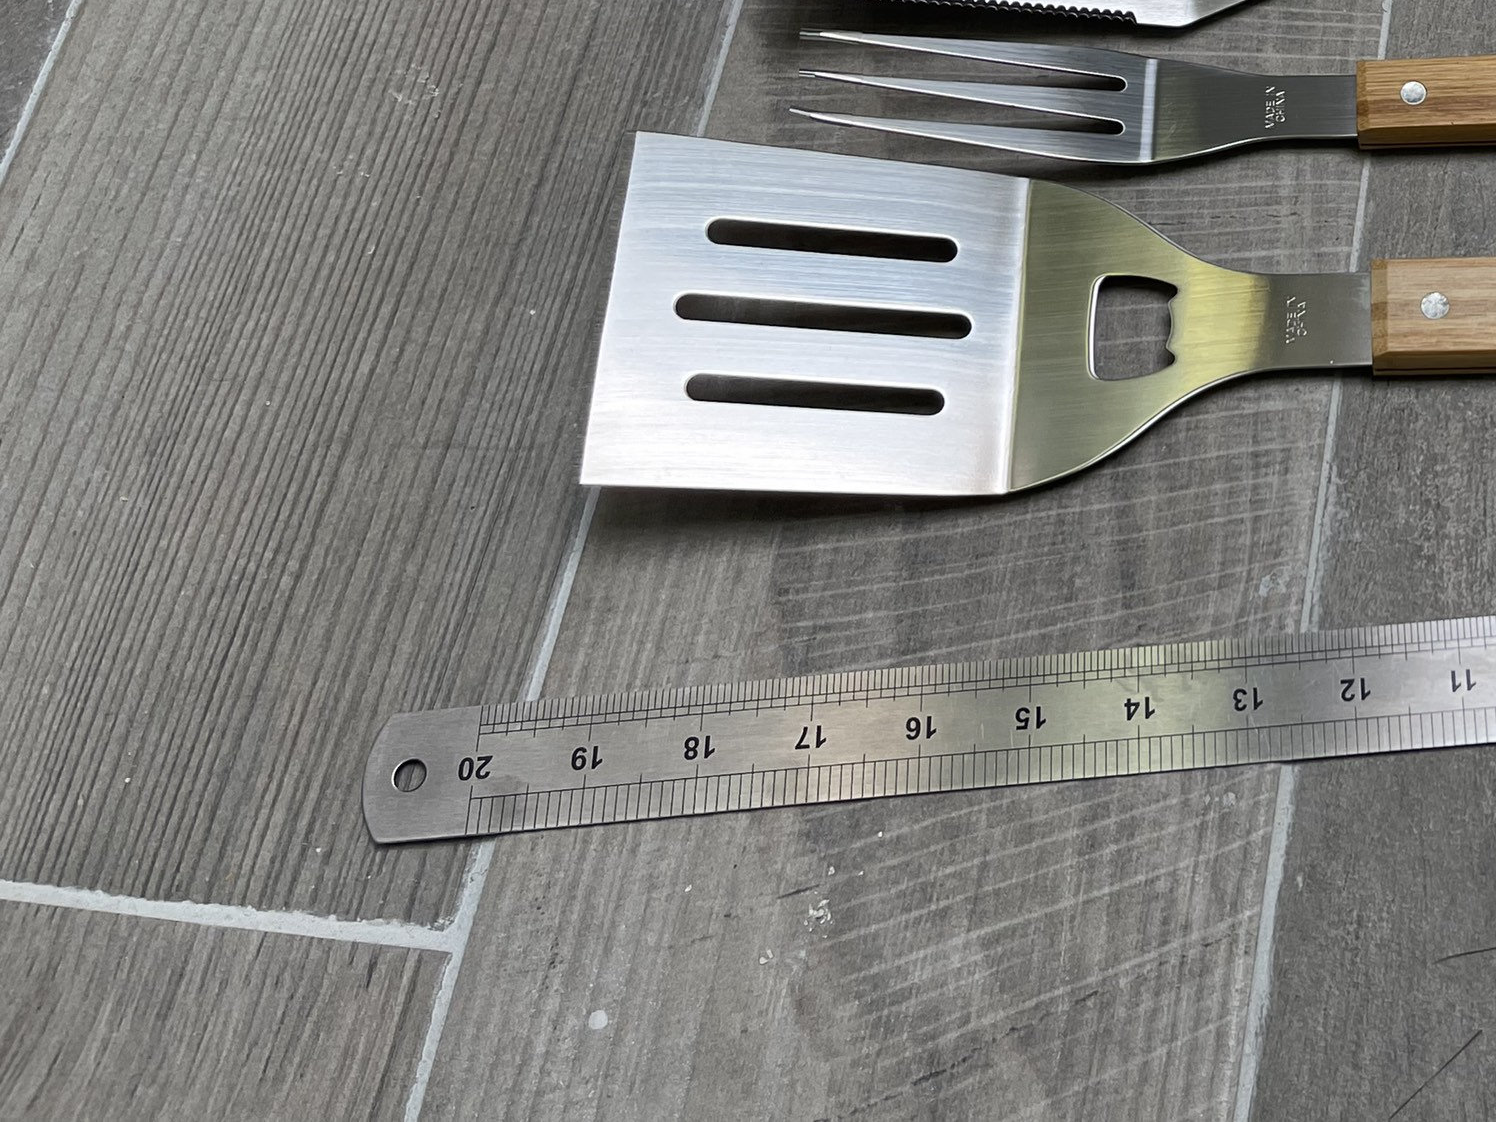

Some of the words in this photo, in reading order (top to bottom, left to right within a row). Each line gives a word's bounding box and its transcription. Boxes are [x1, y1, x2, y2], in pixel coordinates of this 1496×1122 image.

[1340, 677, 1371, 702] 12
[1449, 668, 1477, 692] 11
[1124, 696, 1156, 721] 14
[1232, 687, 1263, 711] 13
[905, 715, 937, 740] 16
[1015, 706, 1047, 731] 15
[684, 735, 716, 760] 18
[795, 725, 827, 750] 17
[458, 755, 492, 781] 20
[571, 745, 603, 770] 19
